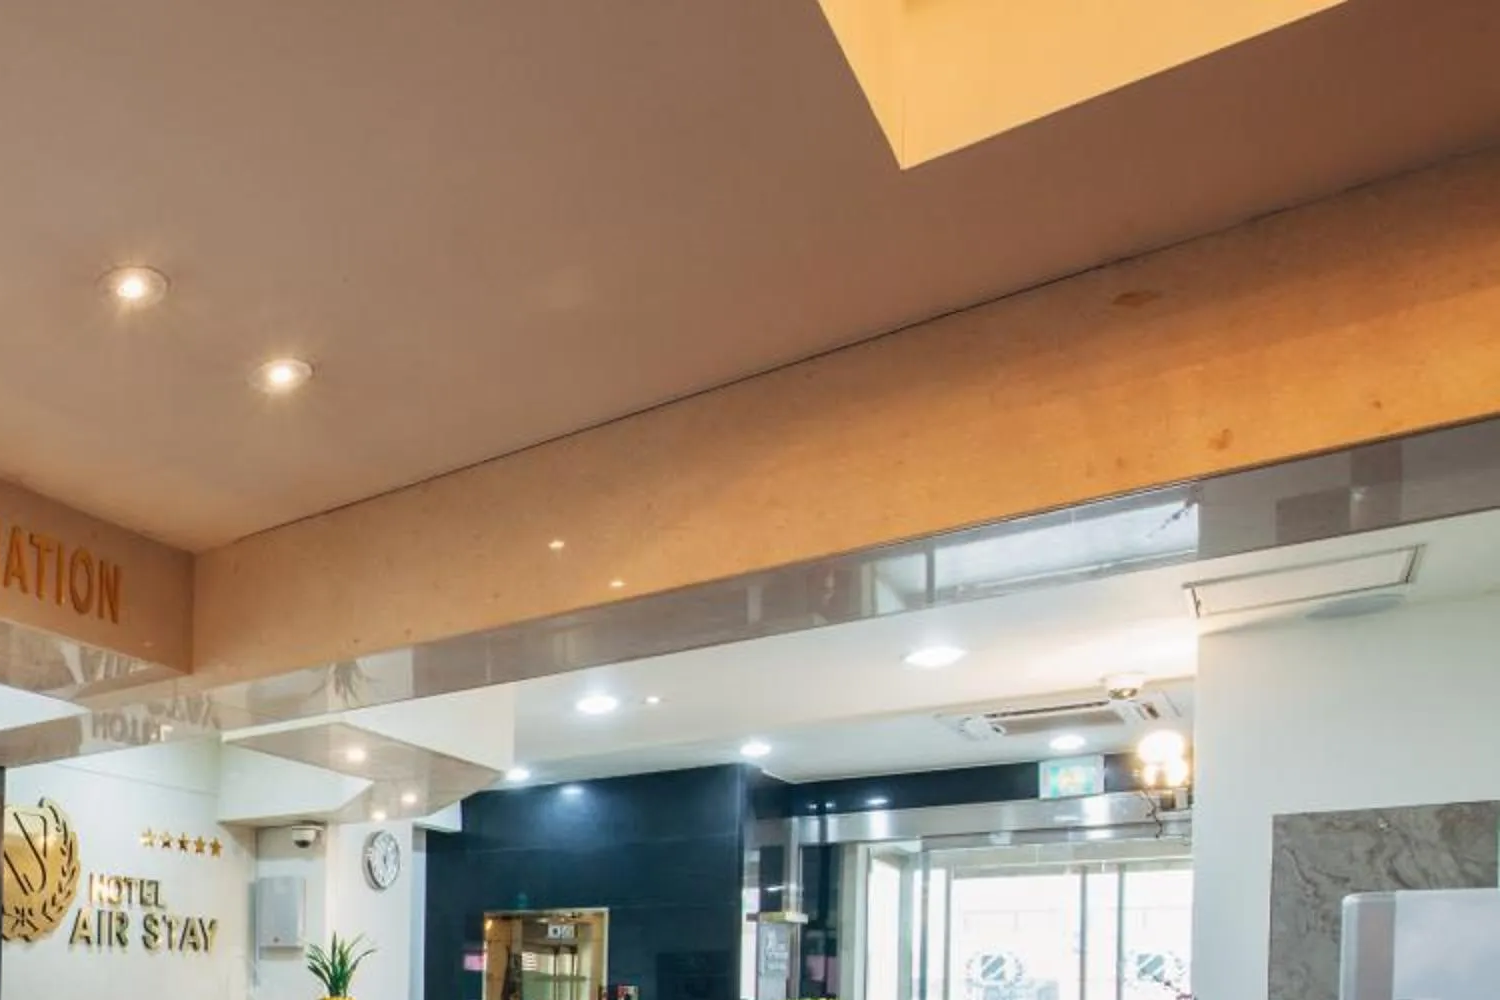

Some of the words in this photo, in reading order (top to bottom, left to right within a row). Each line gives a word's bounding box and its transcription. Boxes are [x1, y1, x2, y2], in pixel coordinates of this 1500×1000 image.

[88, 872, 167, 909] HOTEL
[70, 908, 129, 948] AIR
[141, 912, 217, 951] STAY
